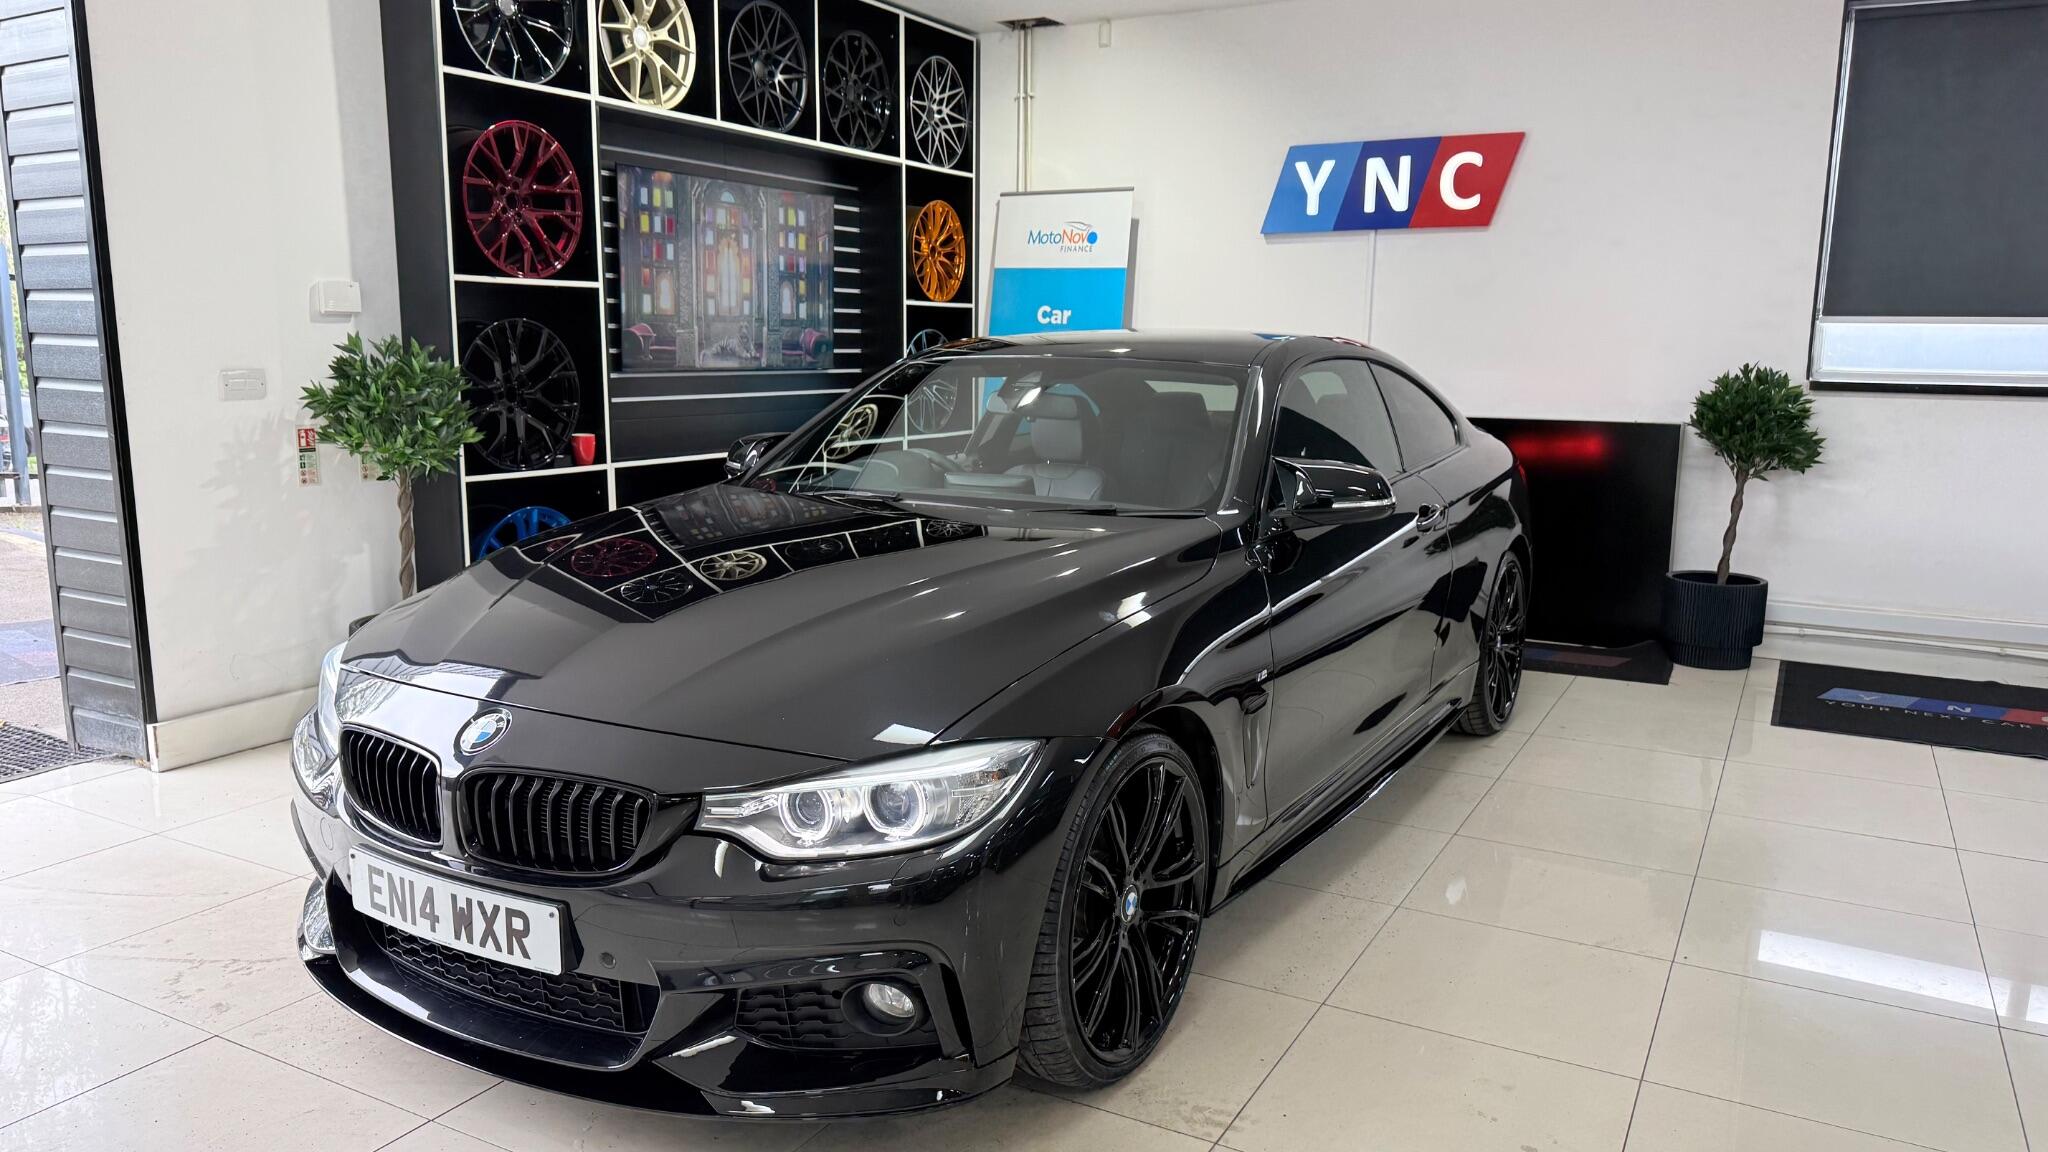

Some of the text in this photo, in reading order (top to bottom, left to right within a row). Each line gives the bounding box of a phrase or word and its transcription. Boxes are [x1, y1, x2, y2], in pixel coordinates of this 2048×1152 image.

[1294, 151, 1484, 216] YNC
[1060, 245, 1093, 253] FINANCE
[1037, 305, 1072, 325] Car
[1825, 700, 1890, 711] YOUR
[1904, 709, 1968, 721] NEXT
[1982, 719, 2032, 729] CAR
[1858, 694, 2048, 724] YN
[367, 864, 532, 961] EN14 WXR
